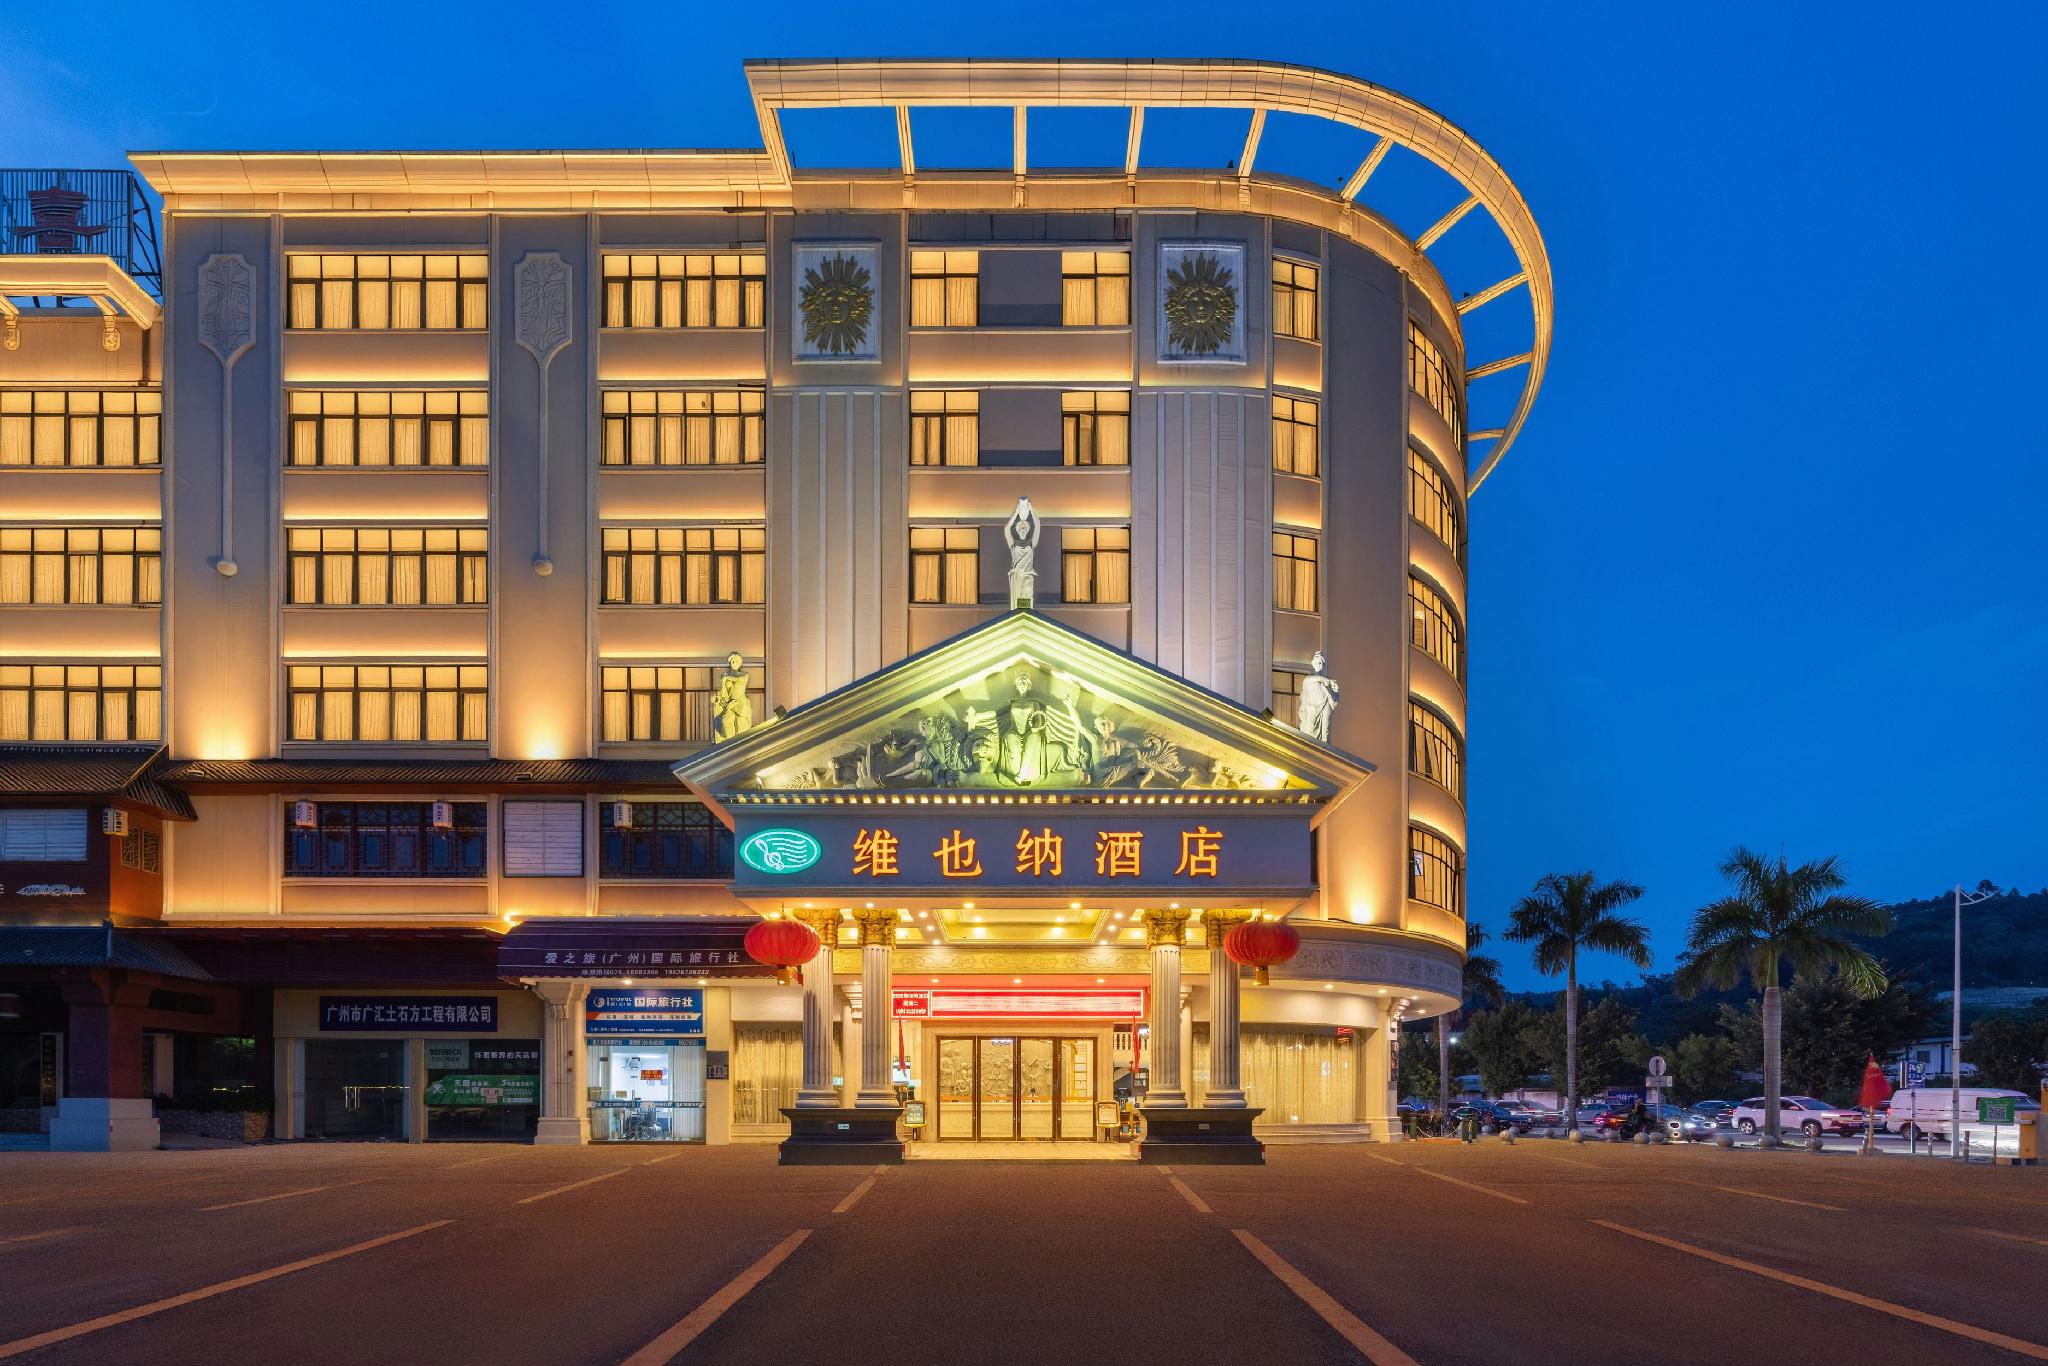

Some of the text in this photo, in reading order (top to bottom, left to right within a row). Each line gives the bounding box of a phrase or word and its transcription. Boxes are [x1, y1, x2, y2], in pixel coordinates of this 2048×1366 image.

[852, 826, 1224, 878] 维也纳酒店
[634, 996, 693, 1008] 国际旅行社
[326, 1004, 491, 1023] 广州市广汇土石方工程有限公司
